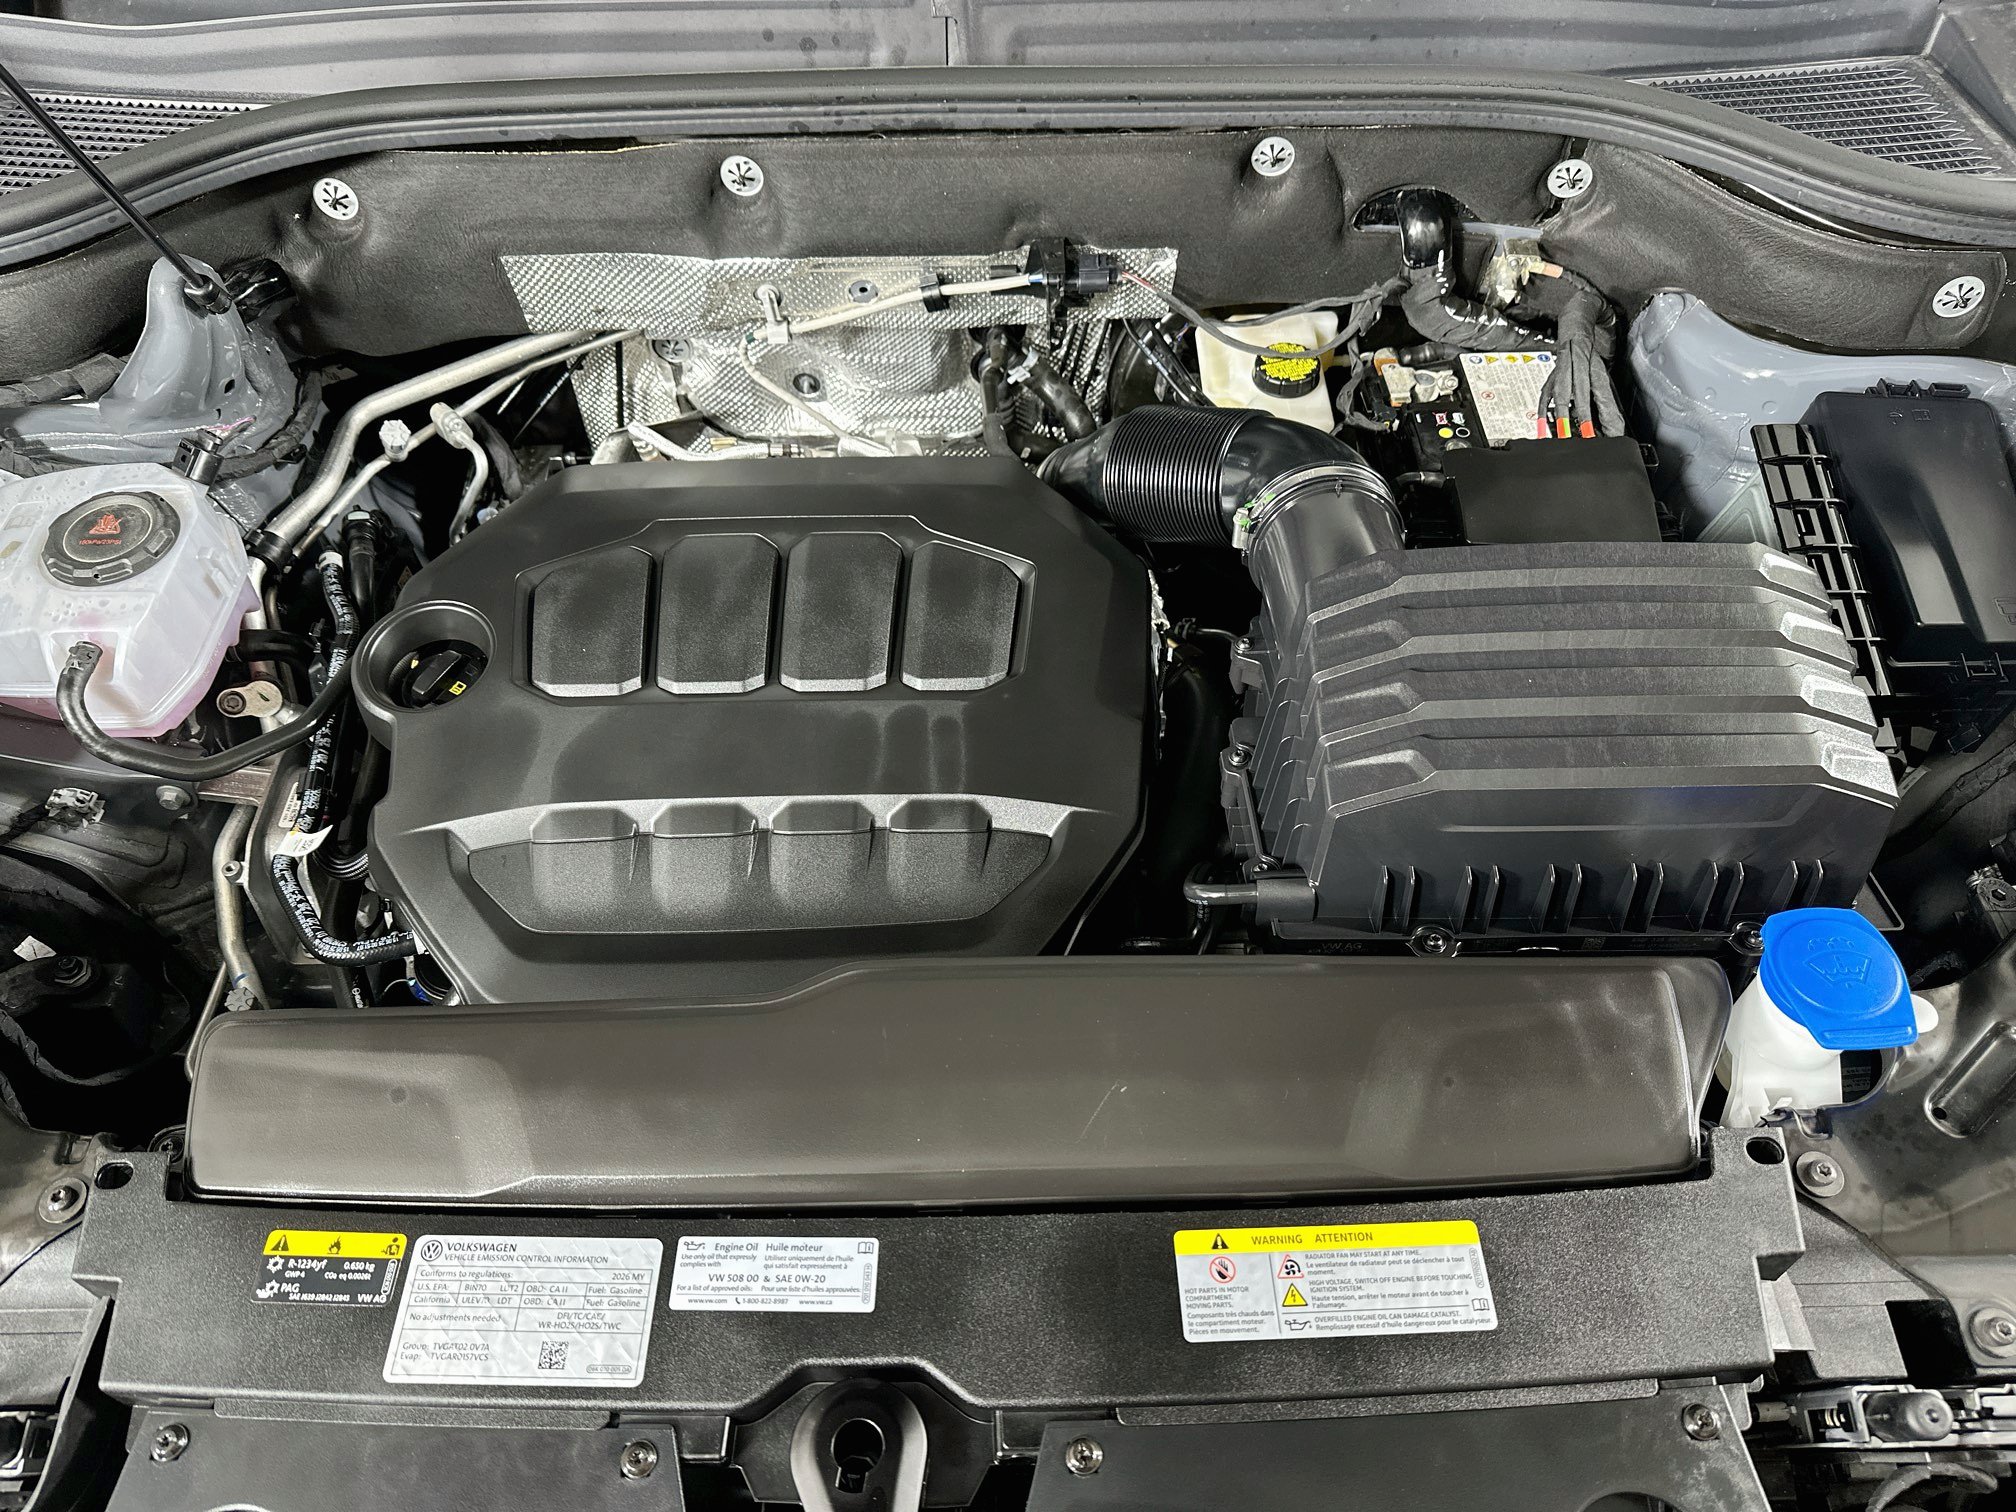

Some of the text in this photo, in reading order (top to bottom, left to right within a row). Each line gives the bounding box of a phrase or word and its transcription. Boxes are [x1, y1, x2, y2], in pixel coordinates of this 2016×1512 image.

[1252, 1232, 1373, 1245] WARNING ATTENTION
[448, 1242, 517, 1252] VOLKSWAGEN
[715, 1243, 759, 1253] Engine Oil
[766, 1243, 823, 1252] Huile moteur
[444, 1253, 609, 1264] VEHICLE EMISSION CONTROL INFORMATION
[693, 1253, 706, 1261] only
[729, 1254, 757, 1262] expressly
[788, 1254, 825, 1263] uniquement
[288, 1259, 328, 1272] R-1234yf
[365, 1262, 376, 1272] kg
[680, 1261, 706, 1269] complies
[800, 1263, 842, 1271] expressément
[420, 1269, 456, 1277] Conforms
[468, 1270, 513, 1280] regulations:
[612, 1272, 645, 1281] 2026 MY
[708, 1274, 725, 1282] VW
[727, 1274, 744, 1282] 508
[746, 1274, 759, 1282] 00
[775, 1274, 792, 1283] SAE
[795, 1274, 826, 1283] 0W-20
[280, 1283, 300, 1292] PAG
[550, 1285, 560, 1293] CA
[588, 1286, 643, 1294] Fuel: Gasoline
[711, 1285, 739, 1293] approved
[357, 1294, 387, 1304] VW AG
[497, 1297, 512, 1305] LDT
[547, 1298, 558, 1306] CA
[608, 1299, 640, 1307] Gasoline
[410, 1313, 501, 1323] No adjustments needed
[1187, 1312, 1224, 1320] Composants
[538, 1321, 622, 1330] WR-HO2S/HO2S/TWC
[1195, 1320, 1240, 1328] compartiment
[1404, 1320, 1436, 1328] dangereux
[400, 1352, 420, 1362] Evap:
